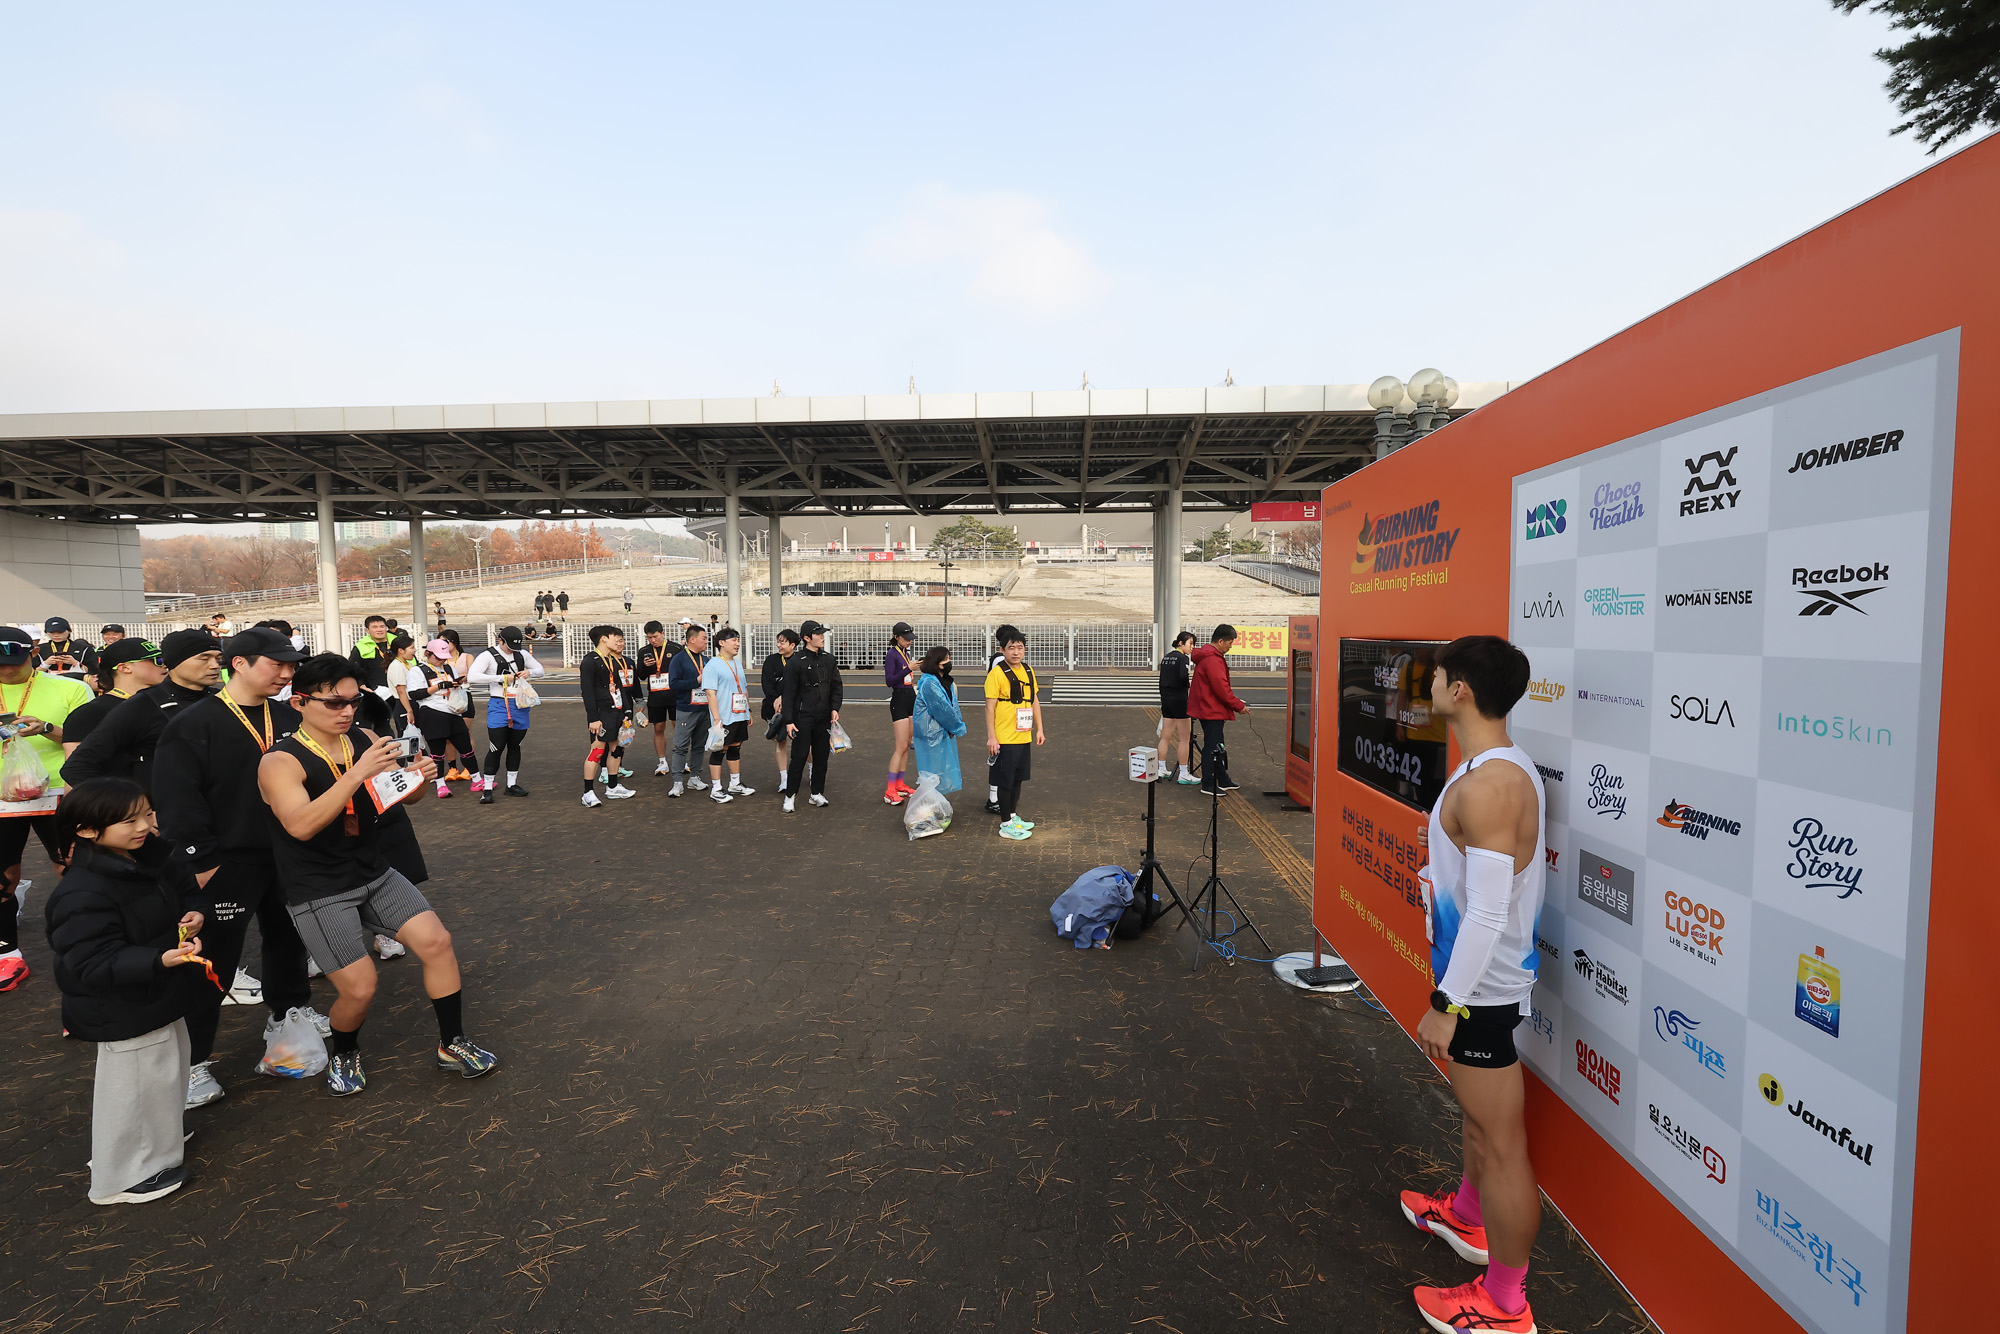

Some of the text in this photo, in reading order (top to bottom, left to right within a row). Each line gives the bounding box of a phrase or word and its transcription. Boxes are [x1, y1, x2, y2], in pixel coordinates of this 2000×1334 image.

[1788, 430, 1904, 473] JOHNBER
[1594, 481, 1641, 507] Choco
[1680, 490, 1741, 517] REXY
[1303, 505, 1316, 518] 남
[1374, 499, 1440, 545] BURNING
[1589, 495, 1645, 530] Health
[1373, 527, 1461, 573] RUN STORY
[1350, 568, 1448, 595] Casual Running Festival
[1792, 562, 1889, 588] Reebok
[1584, 587, 1619, 602] GREEN
[1592, 601, 1645, 616] MONSTER
[1665, 590, 1753, 606] WOMAN SENSE
[1360, 700, 1376, 714] 10km
[1578, 690, 1645, 707] KN INTERNATIONAL
[1399, 710, 1415, 724] 1812
[1355, 735, 1422, 786] 00:33:42
[389, 770, 408, 792] 1518
[1589, 764, 1624, 791] Run
[1587, 786, 1627, 820] Story
[1343, 805, 1374, 843] #버닝런
[1680, 821, 1710, 841] RUN
[1681, 807, 1742, 836] BURNING
[1788, 817, 1858, 856] Run
[1786, 847, 1863, 899] Story
[1583, 874, 1629, 915] 동원샘물
[1665, 890, 1725, 930] GOOD
[1665, 911, 1724, 956] LUCK
[1387, 928, 1428, 980] 버닝런스토리
[1595, 979, 1603, 989] for
[1596, 967, 1628, 998] Habitat
[1464, 1050, 1492, 1059] 2XU
[1682, 1031, 1727, 1079] 피죤
[1576, 1039, 1621, 1107] 일요신문
[1649, 1103, 1702, 1160] 일요신문
[1788, 1099, 1874, 1167] Jamful
[1756, 1189, 1868, 1308] 비즈한국
